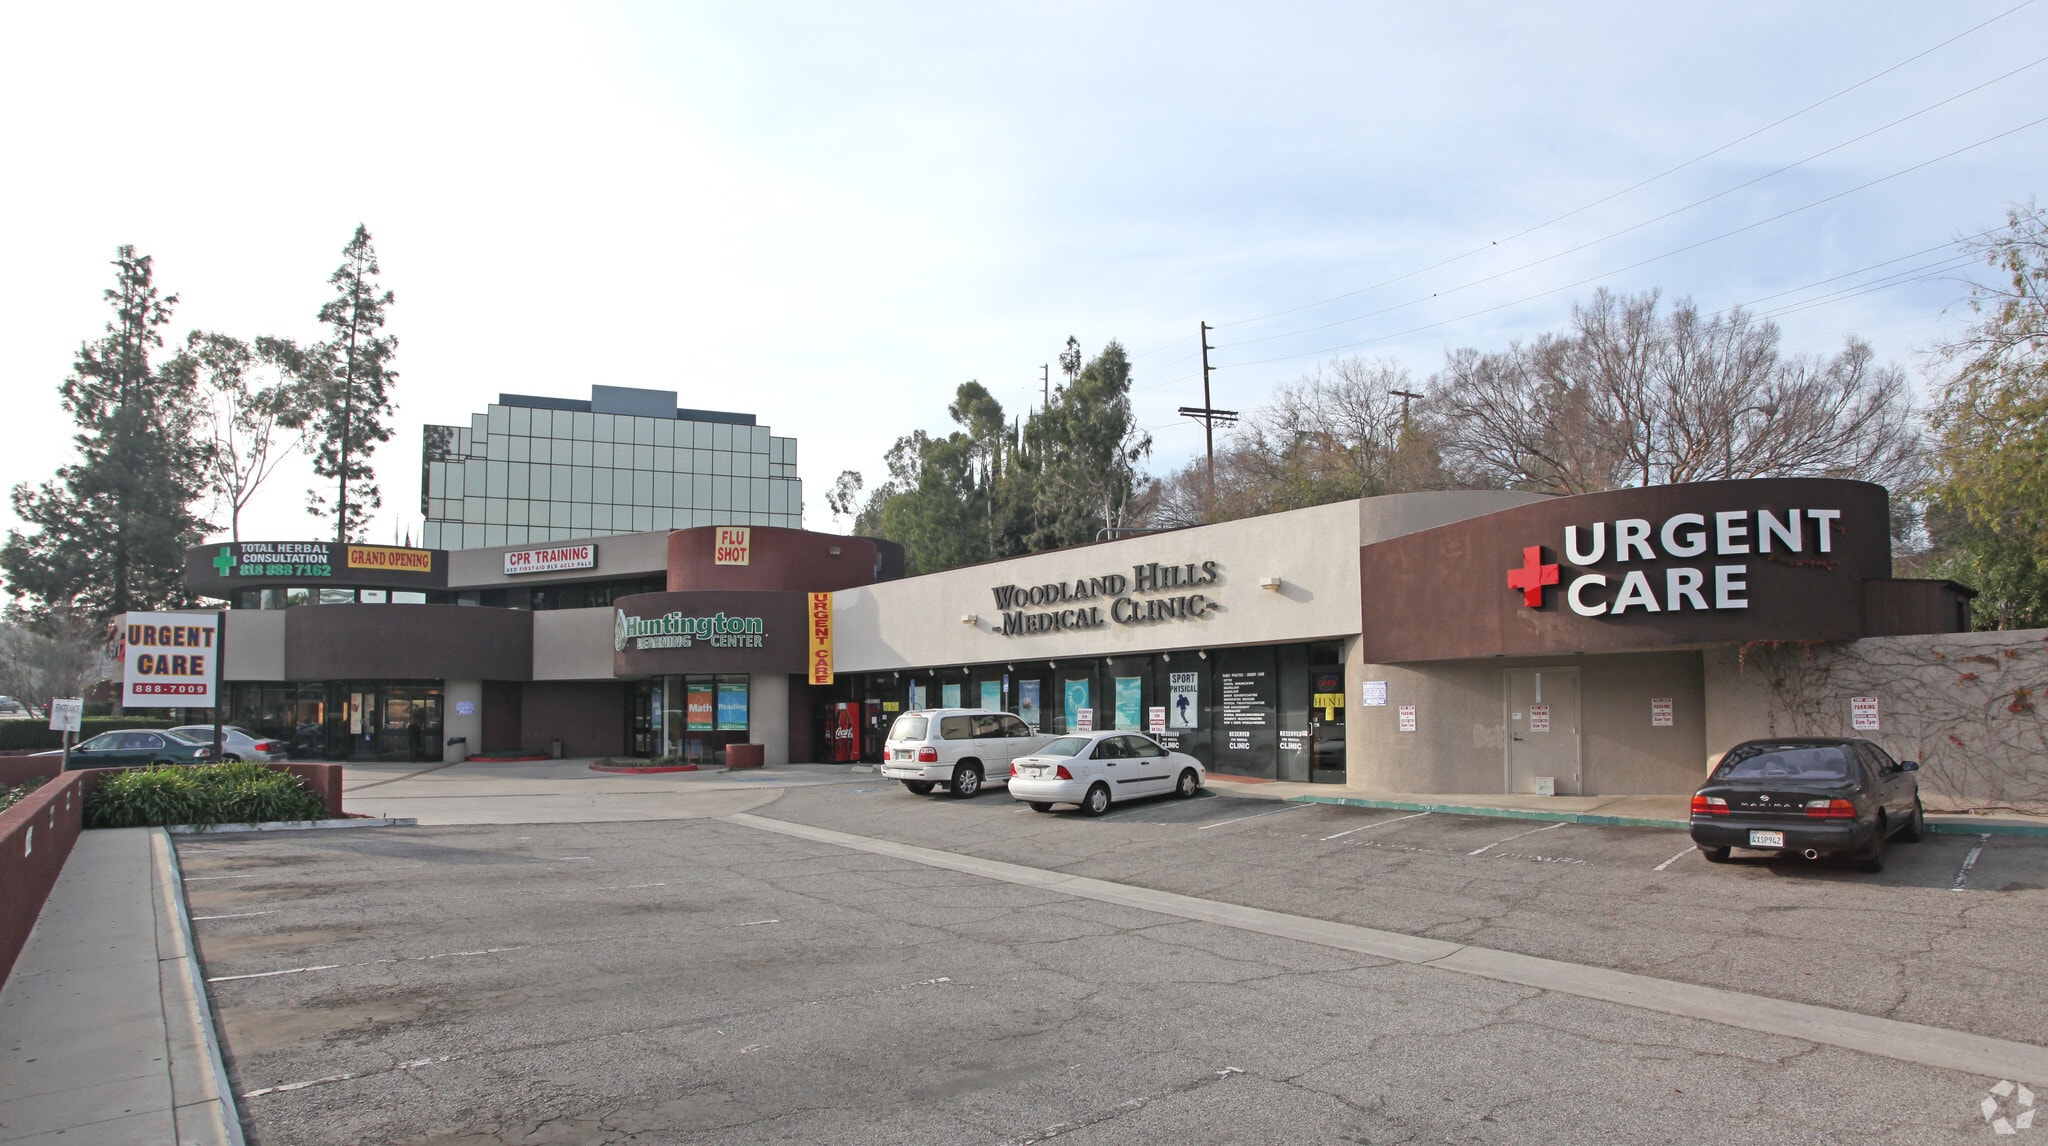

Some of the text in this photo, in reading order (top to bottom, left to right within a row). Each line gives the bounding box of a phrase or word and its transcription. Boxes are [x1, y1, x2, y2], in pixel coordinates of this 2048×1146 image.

[722, 530, 744, 545] FLU
[1565, 508, 1841, 566] URGENT
[241, 543, 330, 554] TOTAL HERBAL
[717, 547, 747, 562] SHOT
[242, 553, 328, 564] CONSULTATION
[351, 550, 429, 568] GRAND OPENING
[510, 547, 589, 566] CPR TRAINING
[240, 564, 264, 576] 818
[294, 564, 332, 577] 7162
[991, 560, 1217, 610] WOODLAND HILLS
[1567, 564, 1749, 617] CARE
[626, 612, 763, 640] Huntington
[127, 624, 216, 648] URGENT
[637, 634, 763, 650] LEARNING CENTER
[813, 593, 829, 684] URGENT CARE
[137, 653, 205, 676] CARE
[1171, 673, 1195, 684] SPORT
[135, 684, 205, 694] 888-7009
[1170, 685, 1198, 693] PHYSICAL
[689, 703, 713, 713] Math
[718, 703, 747, 712] Reading
